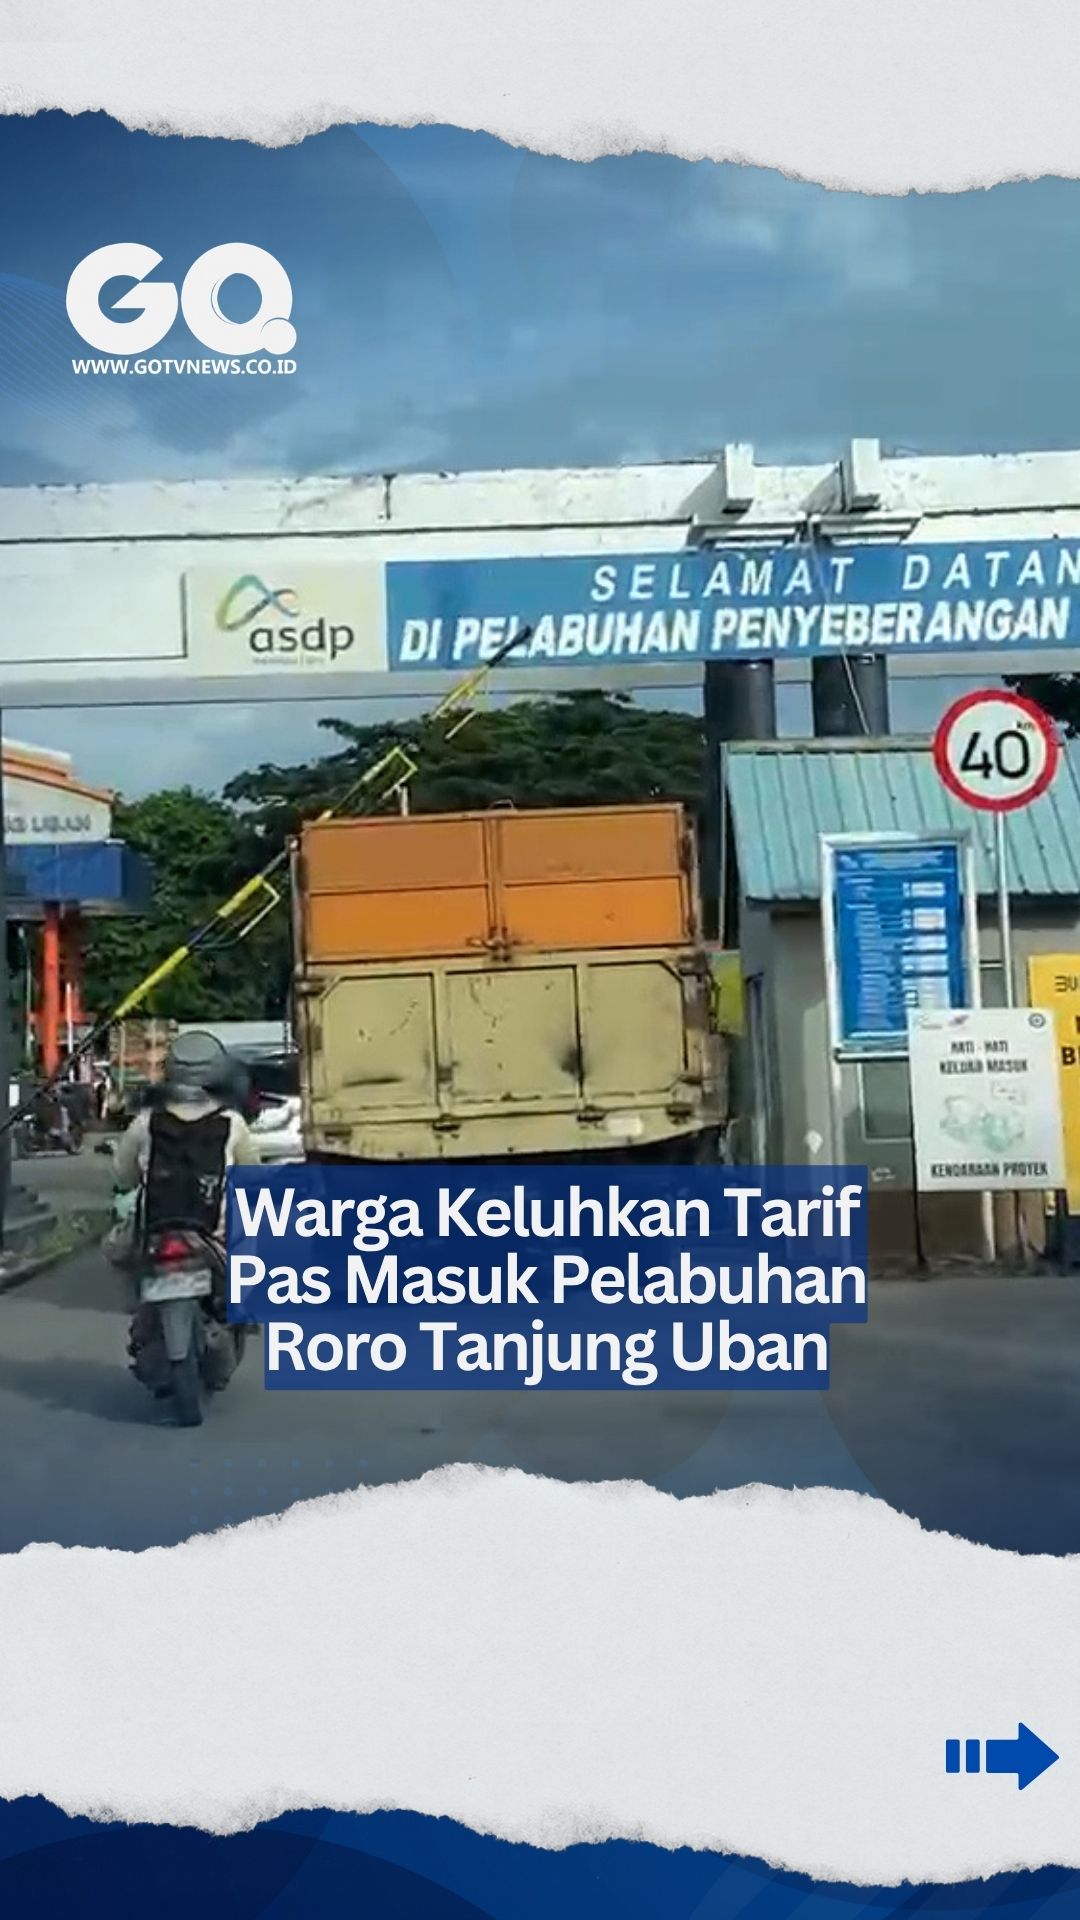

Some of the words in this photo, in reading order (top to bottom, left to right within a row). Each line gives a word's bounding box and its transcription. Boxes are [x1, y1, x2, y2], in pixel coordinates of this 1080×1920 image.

[590, 557, 854, 601] SELAMAT
[248, 617, 355, 661] asdp
[400, 617, 443, 662] DI
[453, 609, 702, 661] PELABUHAN
[711, 597, 1071, 650] PENYEBERANGAN
[960, 730, 1030, 779] 40
[987, 1059, 1028, 1073] MASUK
[1003, 1162, 1048, 1176] PROYEK
